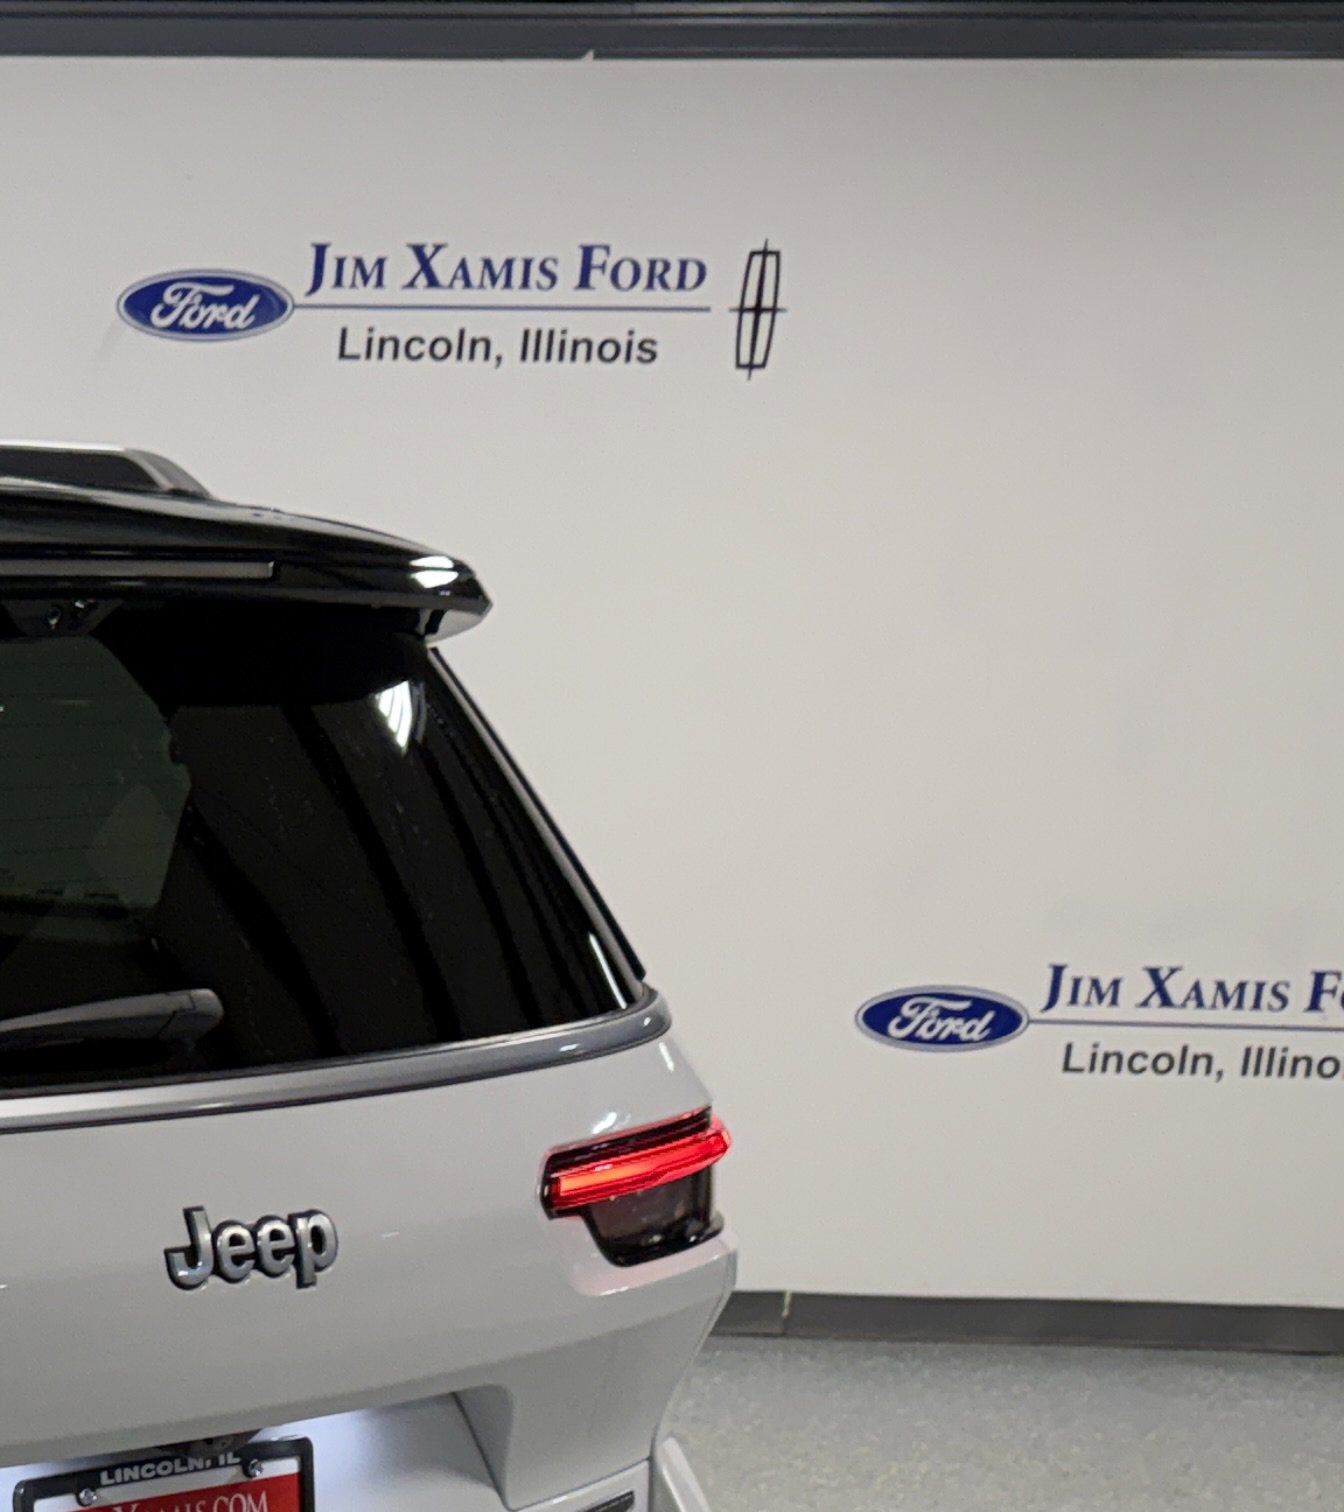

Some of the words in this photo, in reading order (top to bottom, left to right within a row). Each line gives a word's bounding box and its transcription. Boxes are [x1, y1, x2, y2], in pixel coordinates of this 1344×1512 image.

[305, 242, 388, 297] JIM
[402, 244, 559, 291] XAMIS
[576, 244, 707, 292] FORD
[150, 282, 255, 330] Ford
[337, 326, 505, 369] Lincoln,
[518, 328, 659, 364] Illinois
[1040, 963, 1124, 1013] JIM
[1134, 965, 1291, 1012] XAMIS
[1302, 969, 1344, 1013] F
[886, 996, 993, 1042] Ford
[1061, 1042, 1224, 1082] Lincoln,
[1240, 1045, 1344, 1080] Illino
[163, 1205, 339, 1291] Jeep
[100, 1457, 212, 1486] LINCOLN,
[218, 1451, 242, 1466] IL
